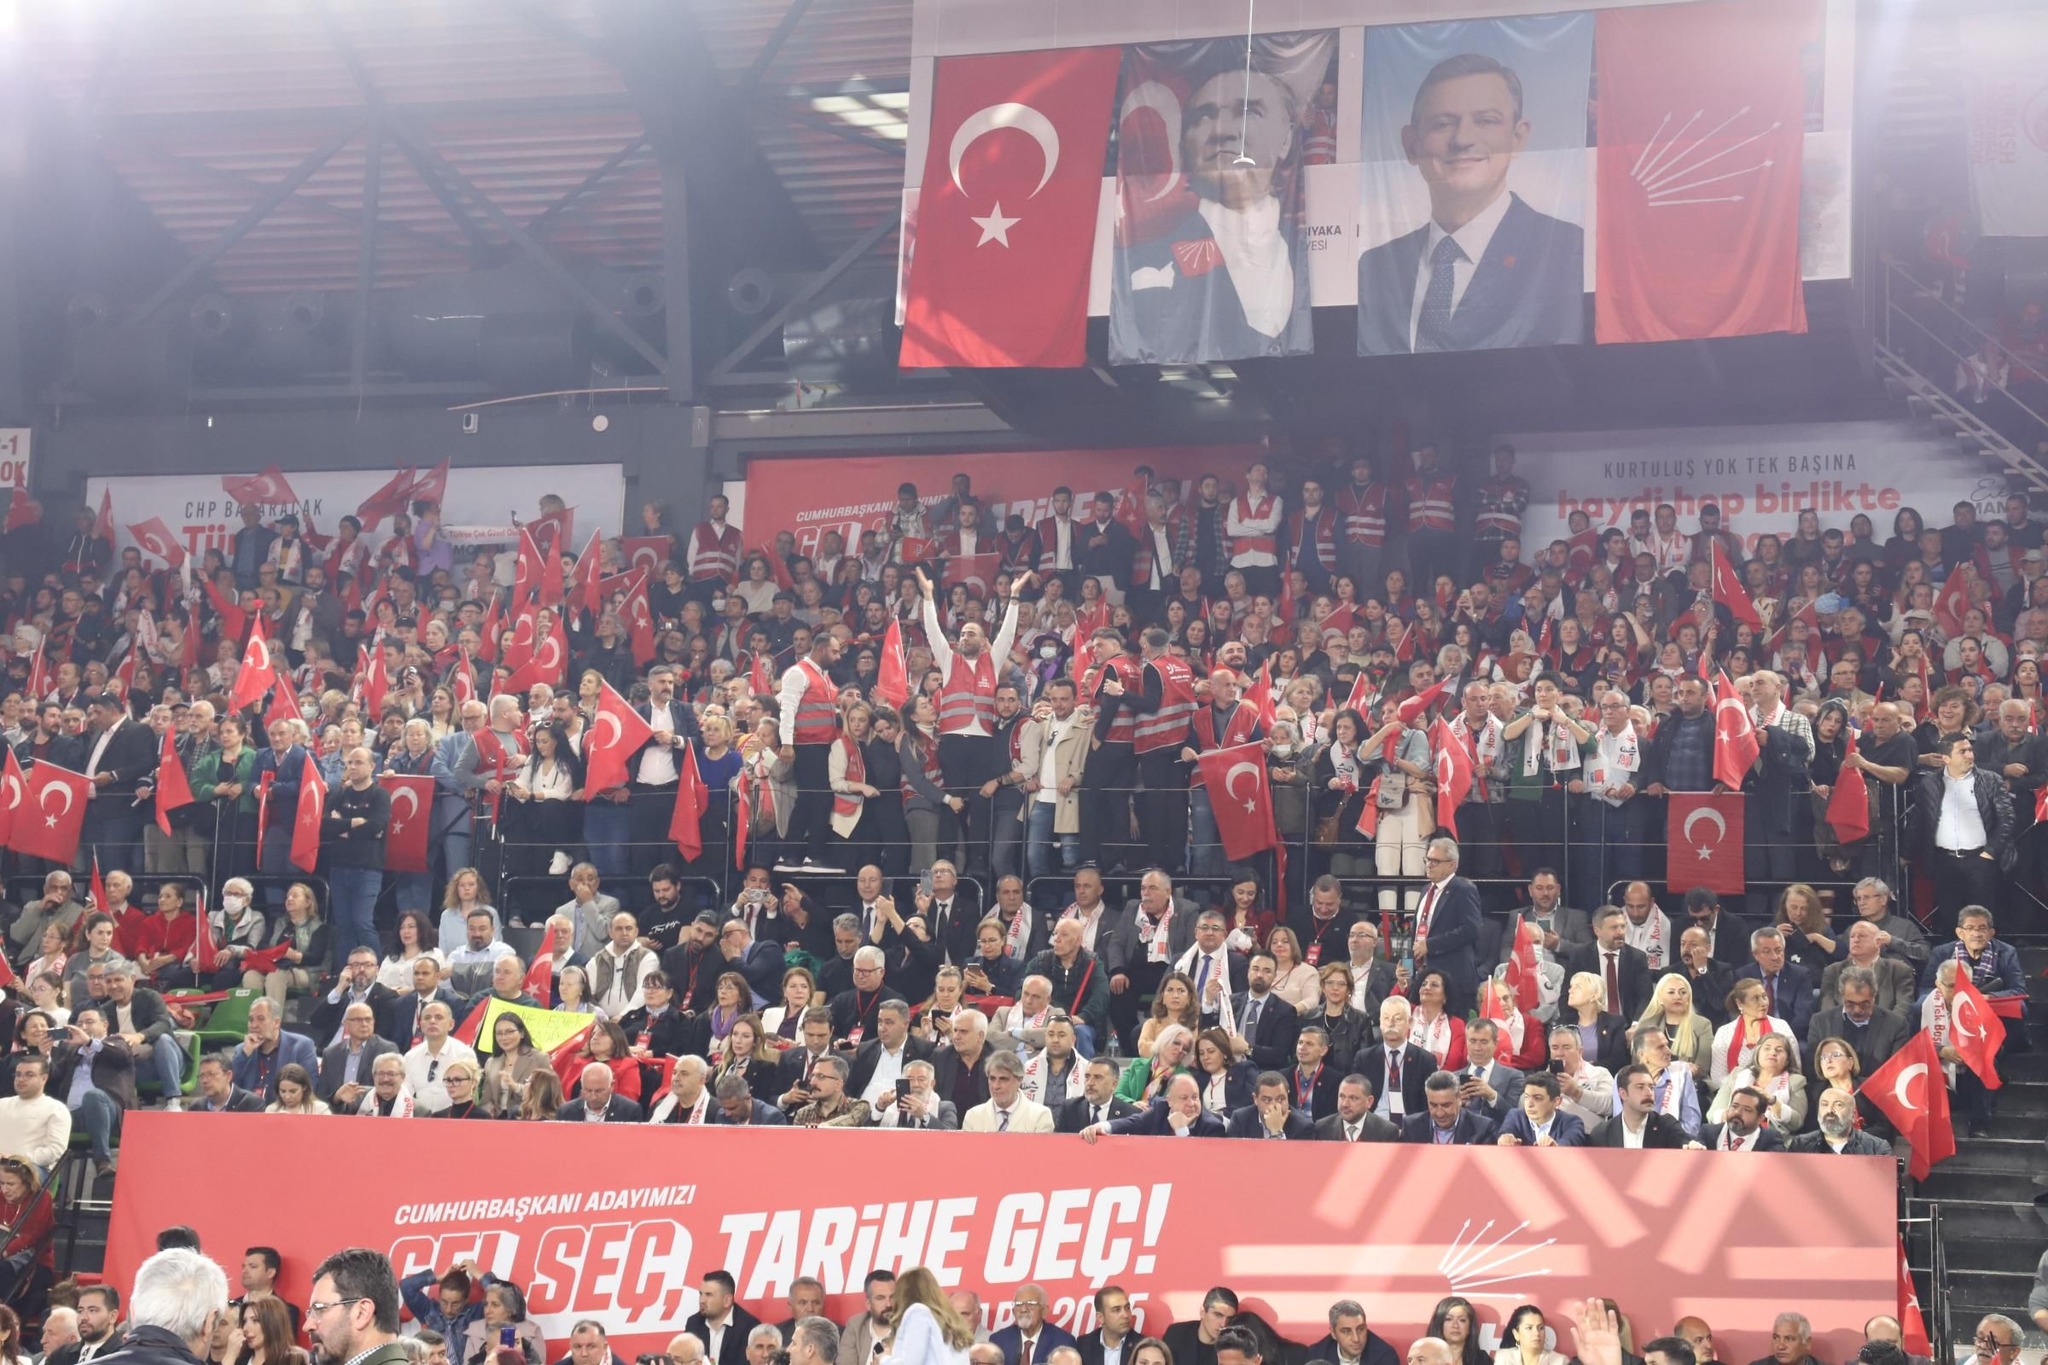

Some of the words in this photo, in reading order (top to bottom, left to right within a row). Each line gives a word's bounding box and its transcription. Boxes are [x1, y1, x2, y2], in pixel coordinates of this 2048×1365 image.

[1604, 460, 1696, 479] KURTULUŞ
[1704, 458, 1737, 475] YOK
[1747, 456, 1778, 474] TEK
[1788, 454, 1856, 475] BAŞINA
[185, 501, 217, 518] CHP
[225, 498, 323, 518] BAARACAK
[796, 501, 893, 522] CUMHURBAŞKANI
[1755, 480, 1901, 514] birlikte
[394, 1193, 581, 1225] CUMHURBAŞKANI
[584, 1184, 697, 1213] ADAYIMIZI
[983, 1183, 1173, 1289] GEÇ!
[1052, 1292, 1149, 1338] 205
